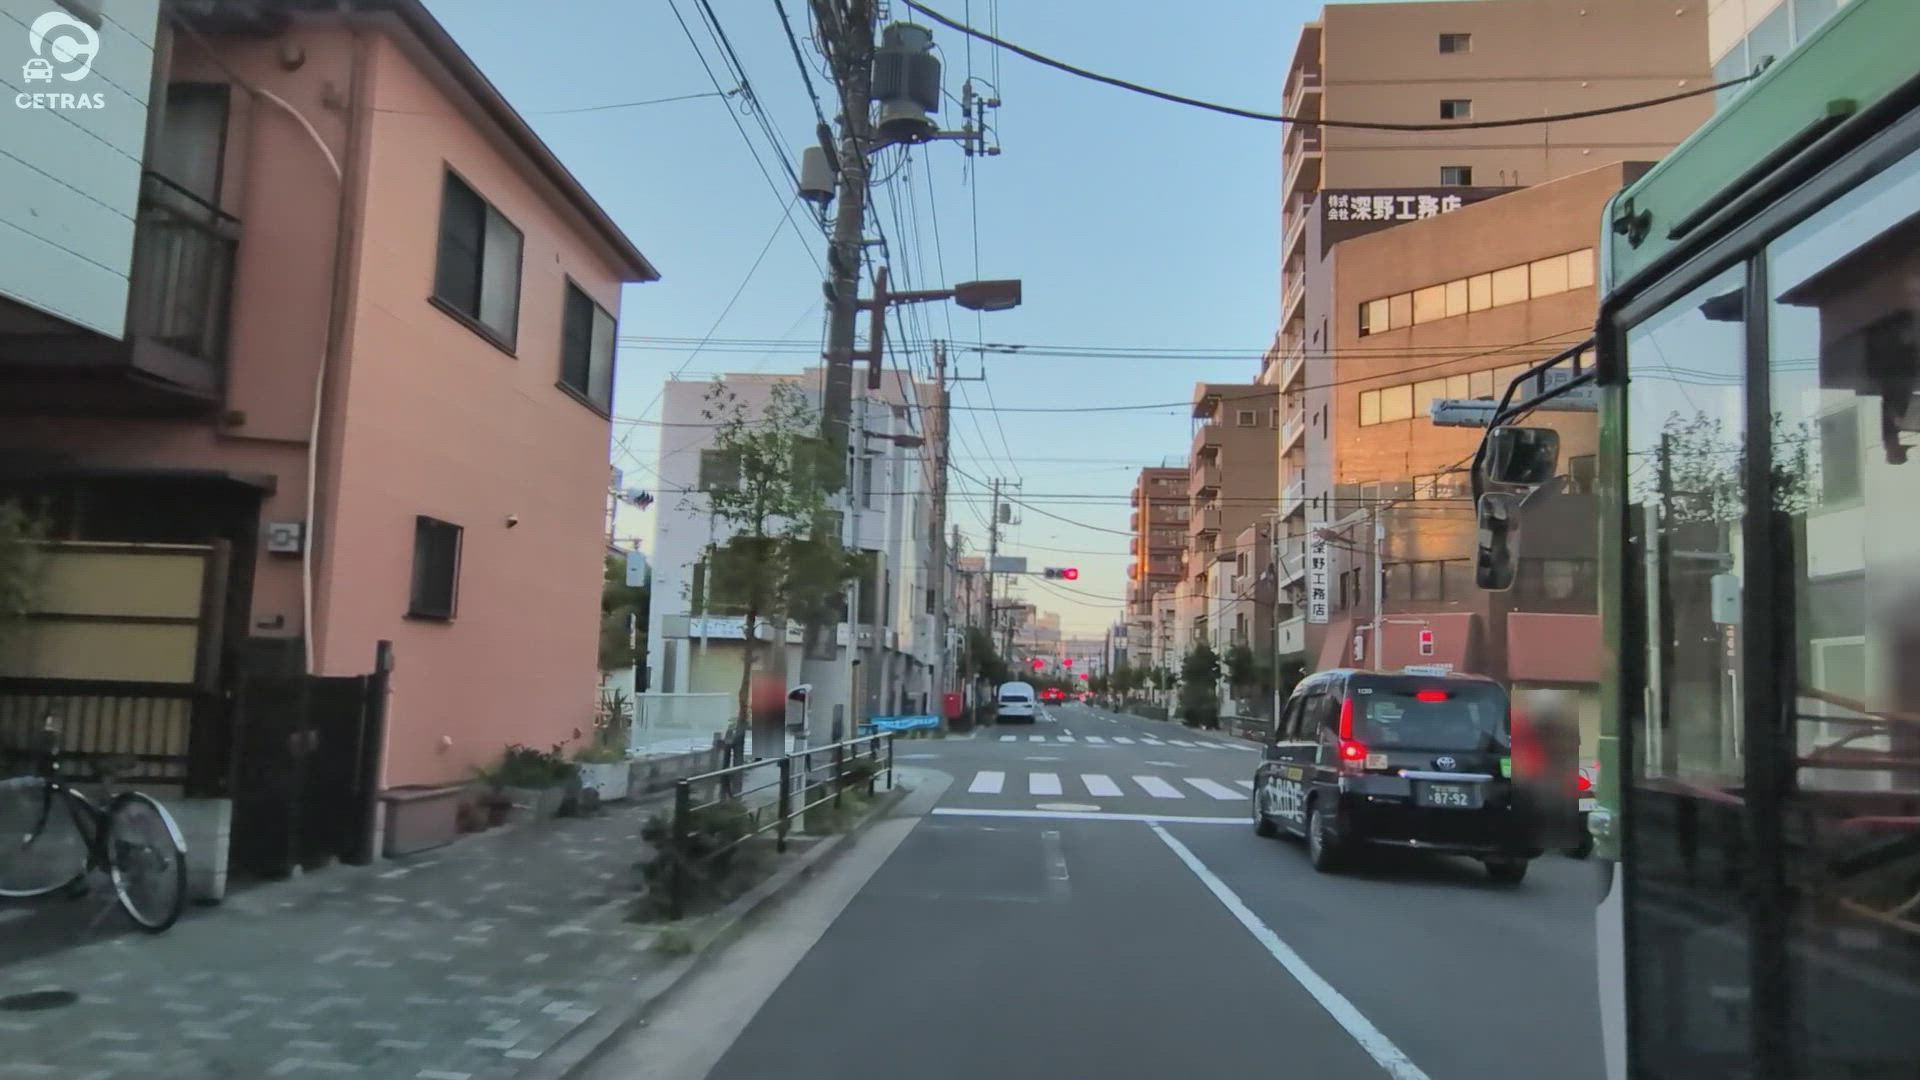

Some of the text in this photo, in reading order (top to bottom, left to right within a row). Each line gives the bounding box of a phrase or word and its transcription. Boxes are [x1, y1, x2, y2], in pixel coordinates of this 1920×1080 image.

[1350, 194, 1462, 221] 深野工務店
